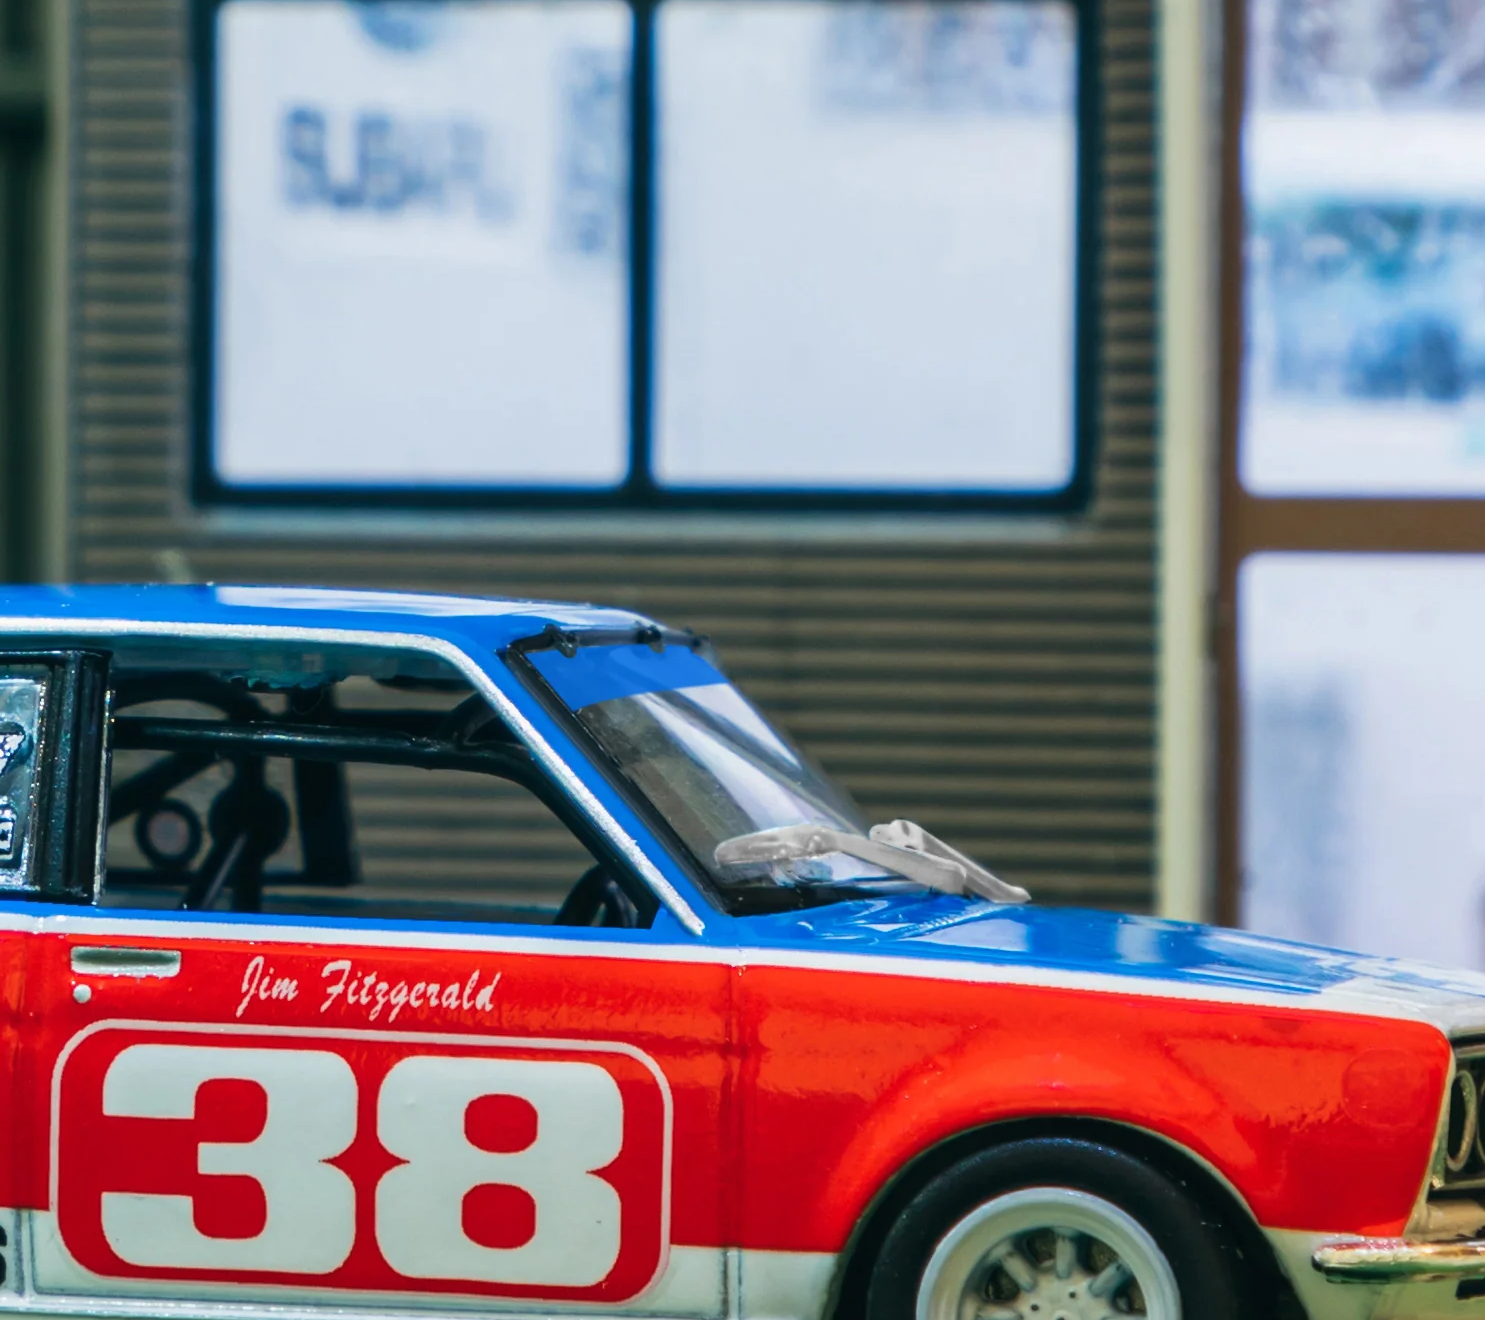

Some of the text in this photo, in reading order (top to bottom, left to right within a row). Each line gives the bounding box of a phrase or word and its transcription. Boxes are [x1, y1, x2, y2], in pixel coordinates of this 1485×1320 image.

[235, 955, 502, 1023] Jim Fitzgerald
[100, 1043, 625, 1288] 38
